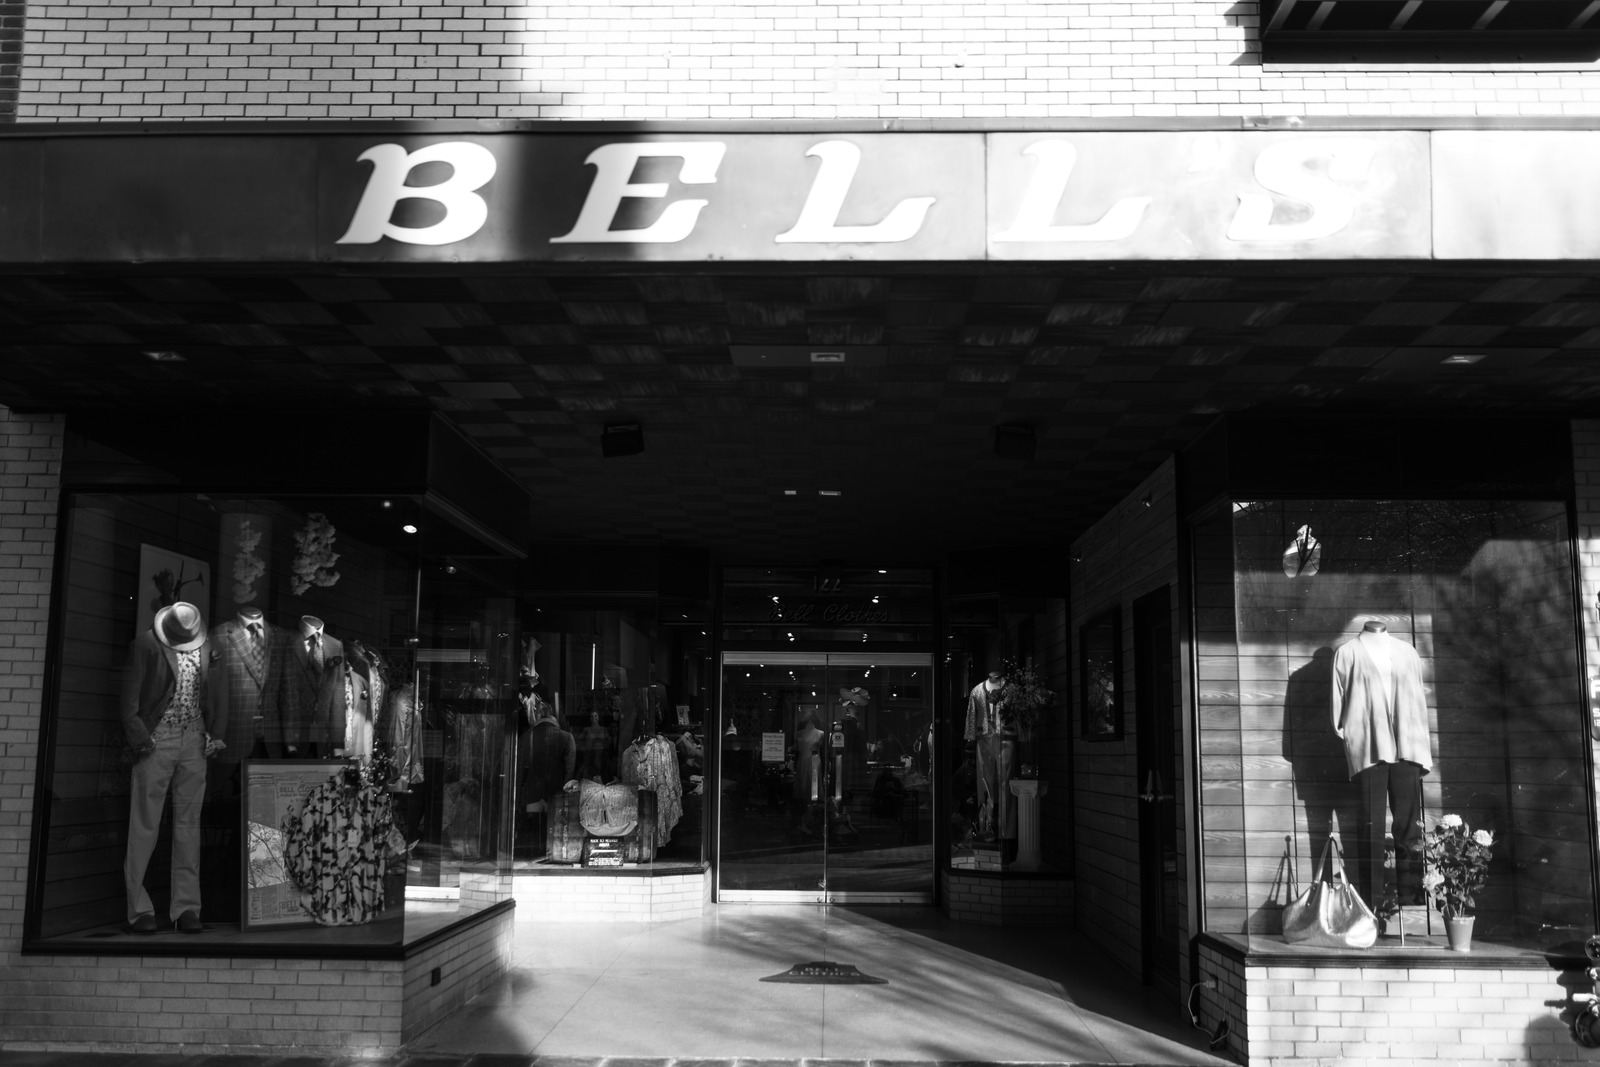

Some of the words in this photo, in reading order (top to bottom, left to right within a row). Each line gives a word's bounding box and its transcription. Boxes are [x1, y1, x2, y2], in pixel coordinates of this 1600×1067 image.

[813, 576, 844, 593] 122
[768, 603, 815, 622] Bell
[823, 603, 888, 623] Clothes
